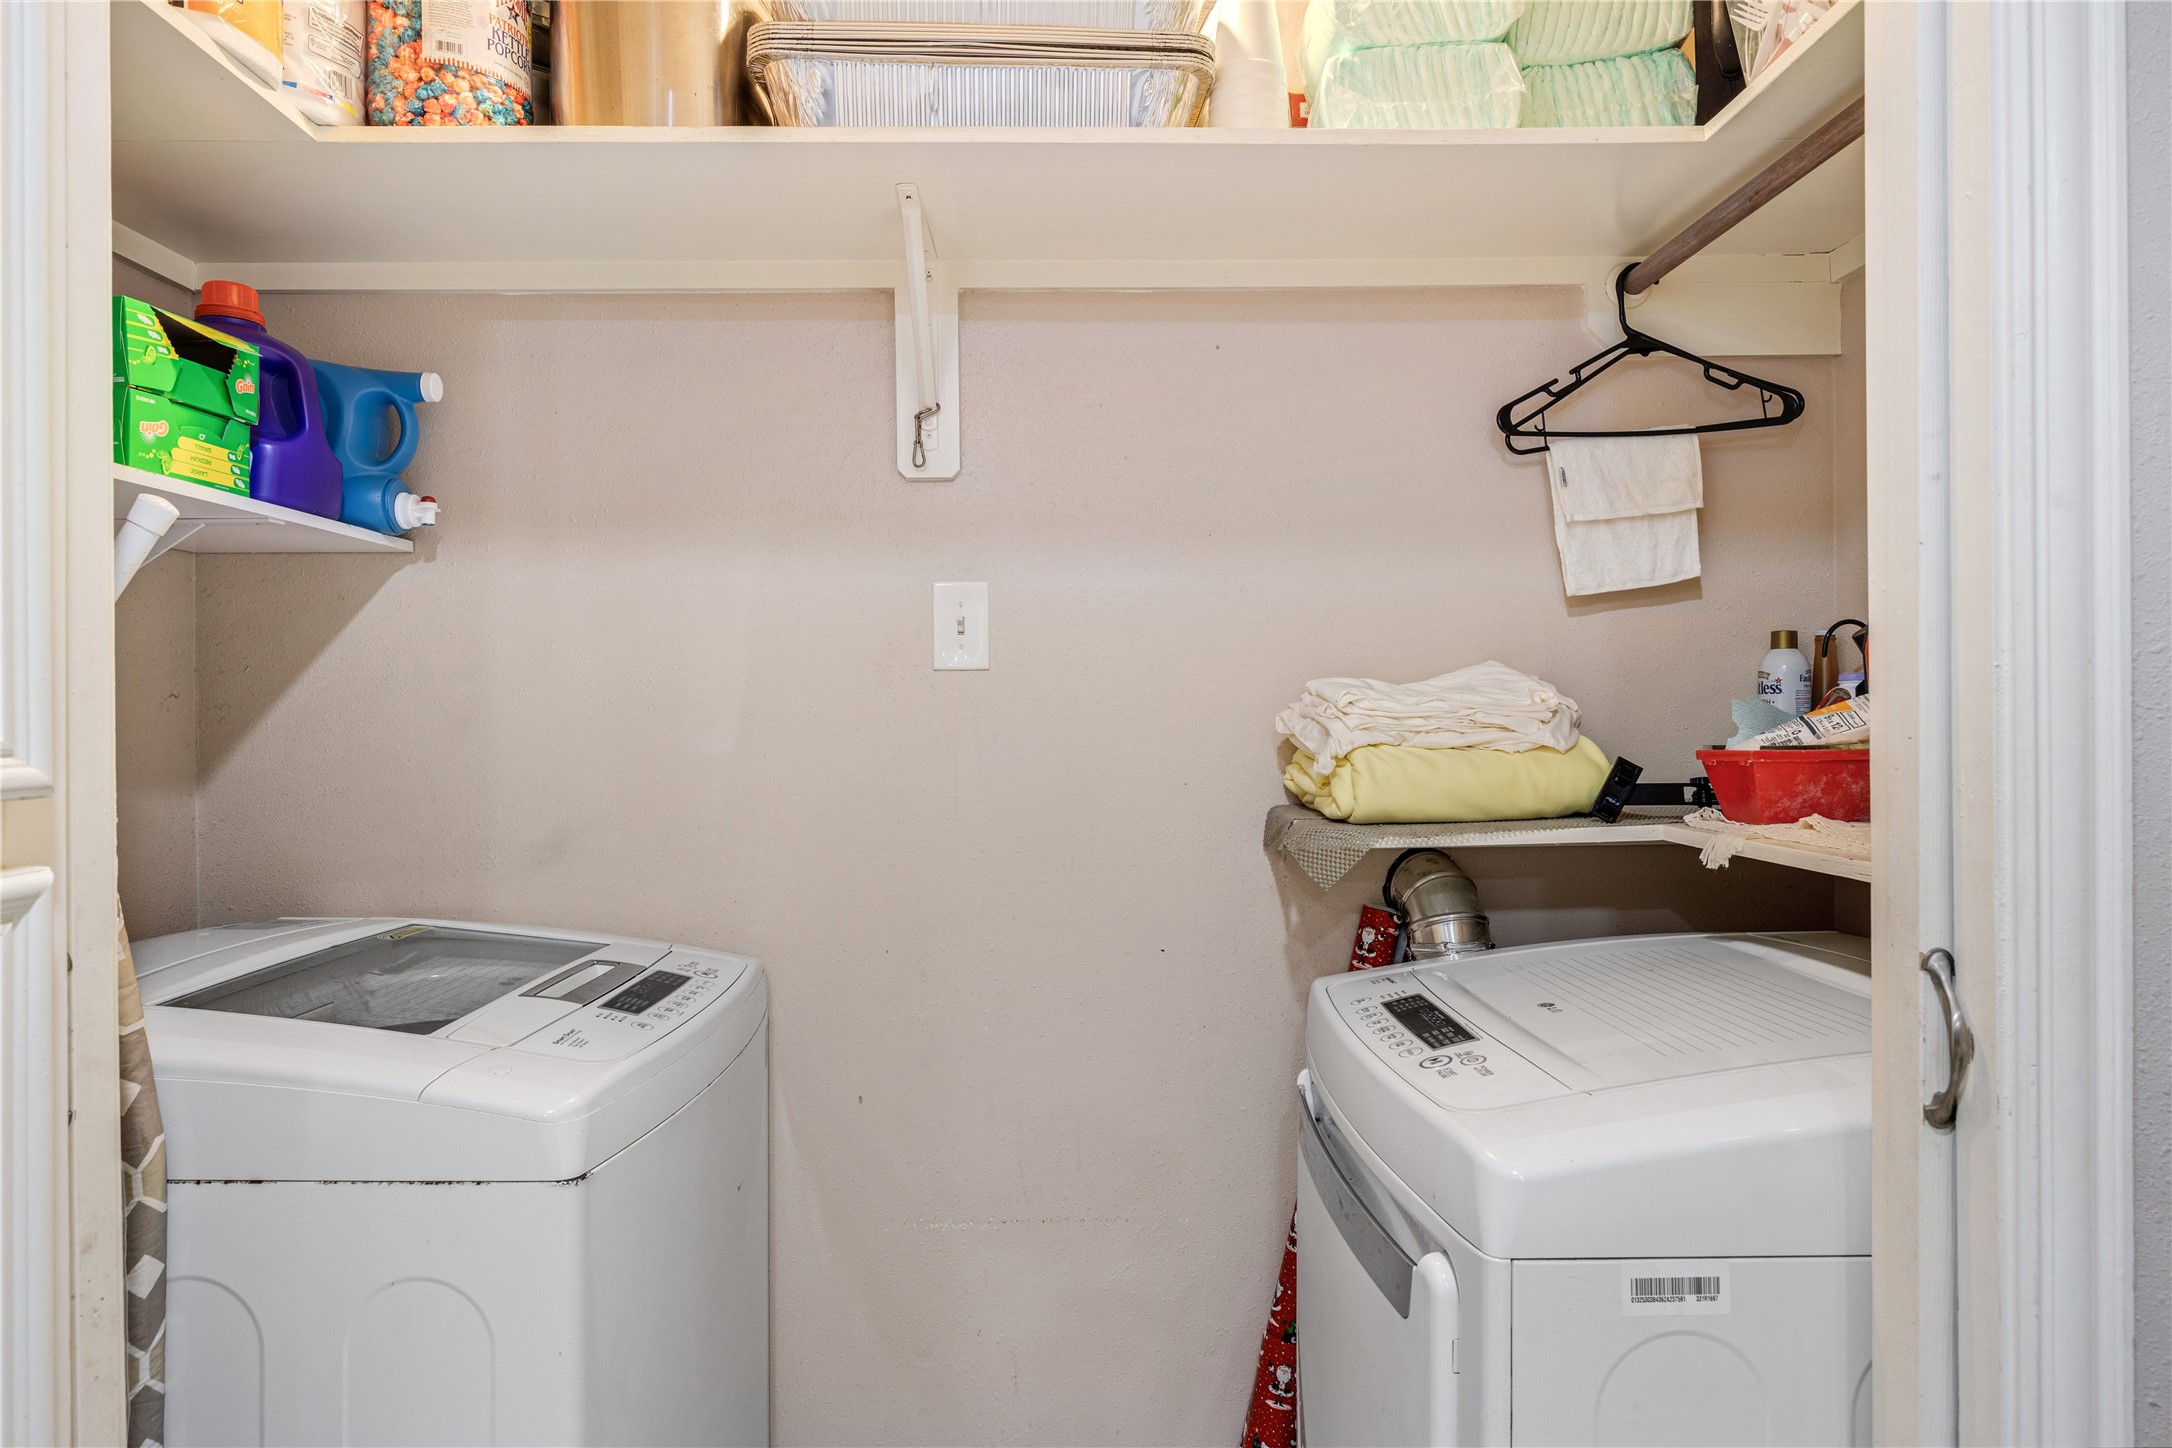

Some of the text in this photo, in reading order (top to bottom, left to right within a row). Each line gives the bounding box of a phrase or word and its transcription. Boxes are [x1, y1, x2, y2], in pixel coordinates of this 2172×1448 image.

[235, 378, 255, 395] Gain
[140, 420, 169, 437] Gain
[194, 443, 212, 454] SMALL
[189, 455, 212, 466] MEDIUM
[189, 467, 208, 477] LARGE
